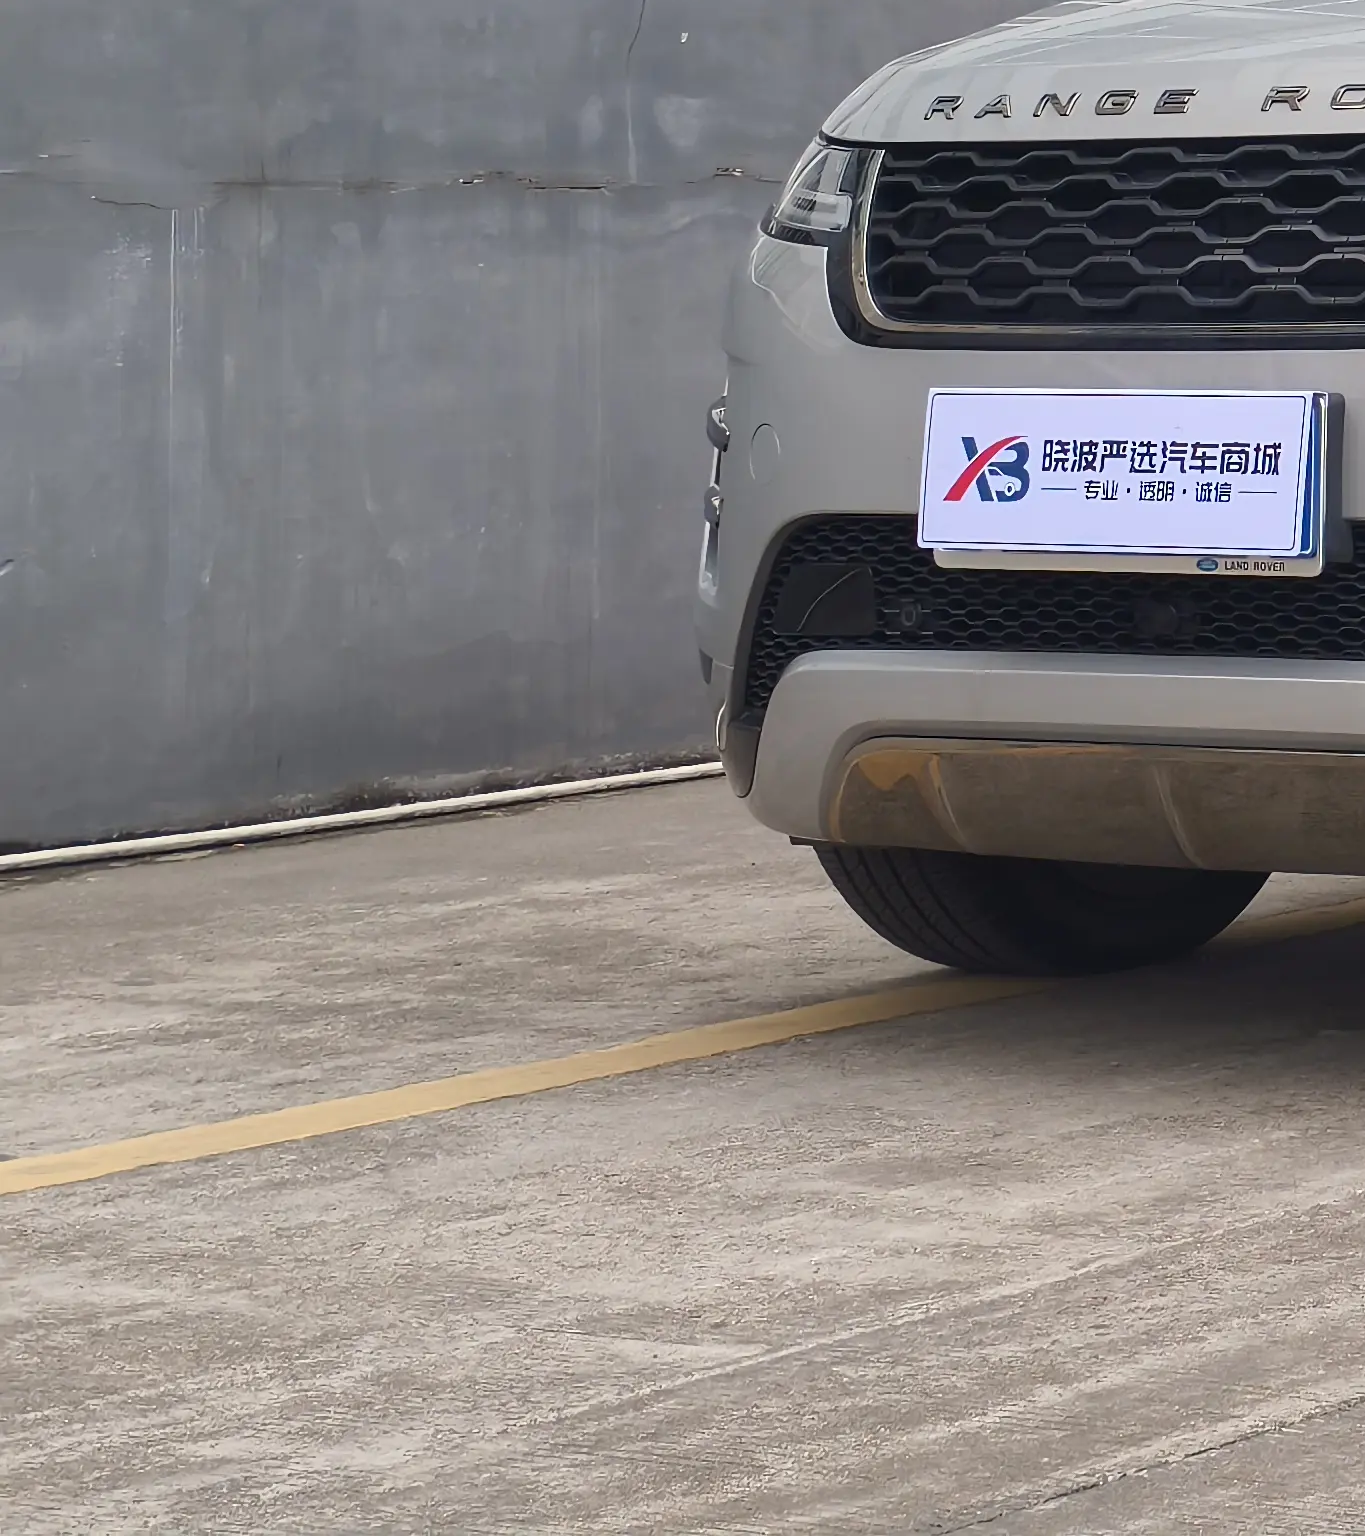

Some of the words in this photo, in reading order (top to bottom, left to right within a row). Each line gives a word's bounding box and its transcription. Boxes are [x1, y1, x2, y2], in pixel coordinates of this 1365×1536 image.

[924, 89, 1199, 120] RANGE
[1042, 439, 1282, 475] 晓波严选汽车商城
[1224, 561, 1249, 571] LAND
